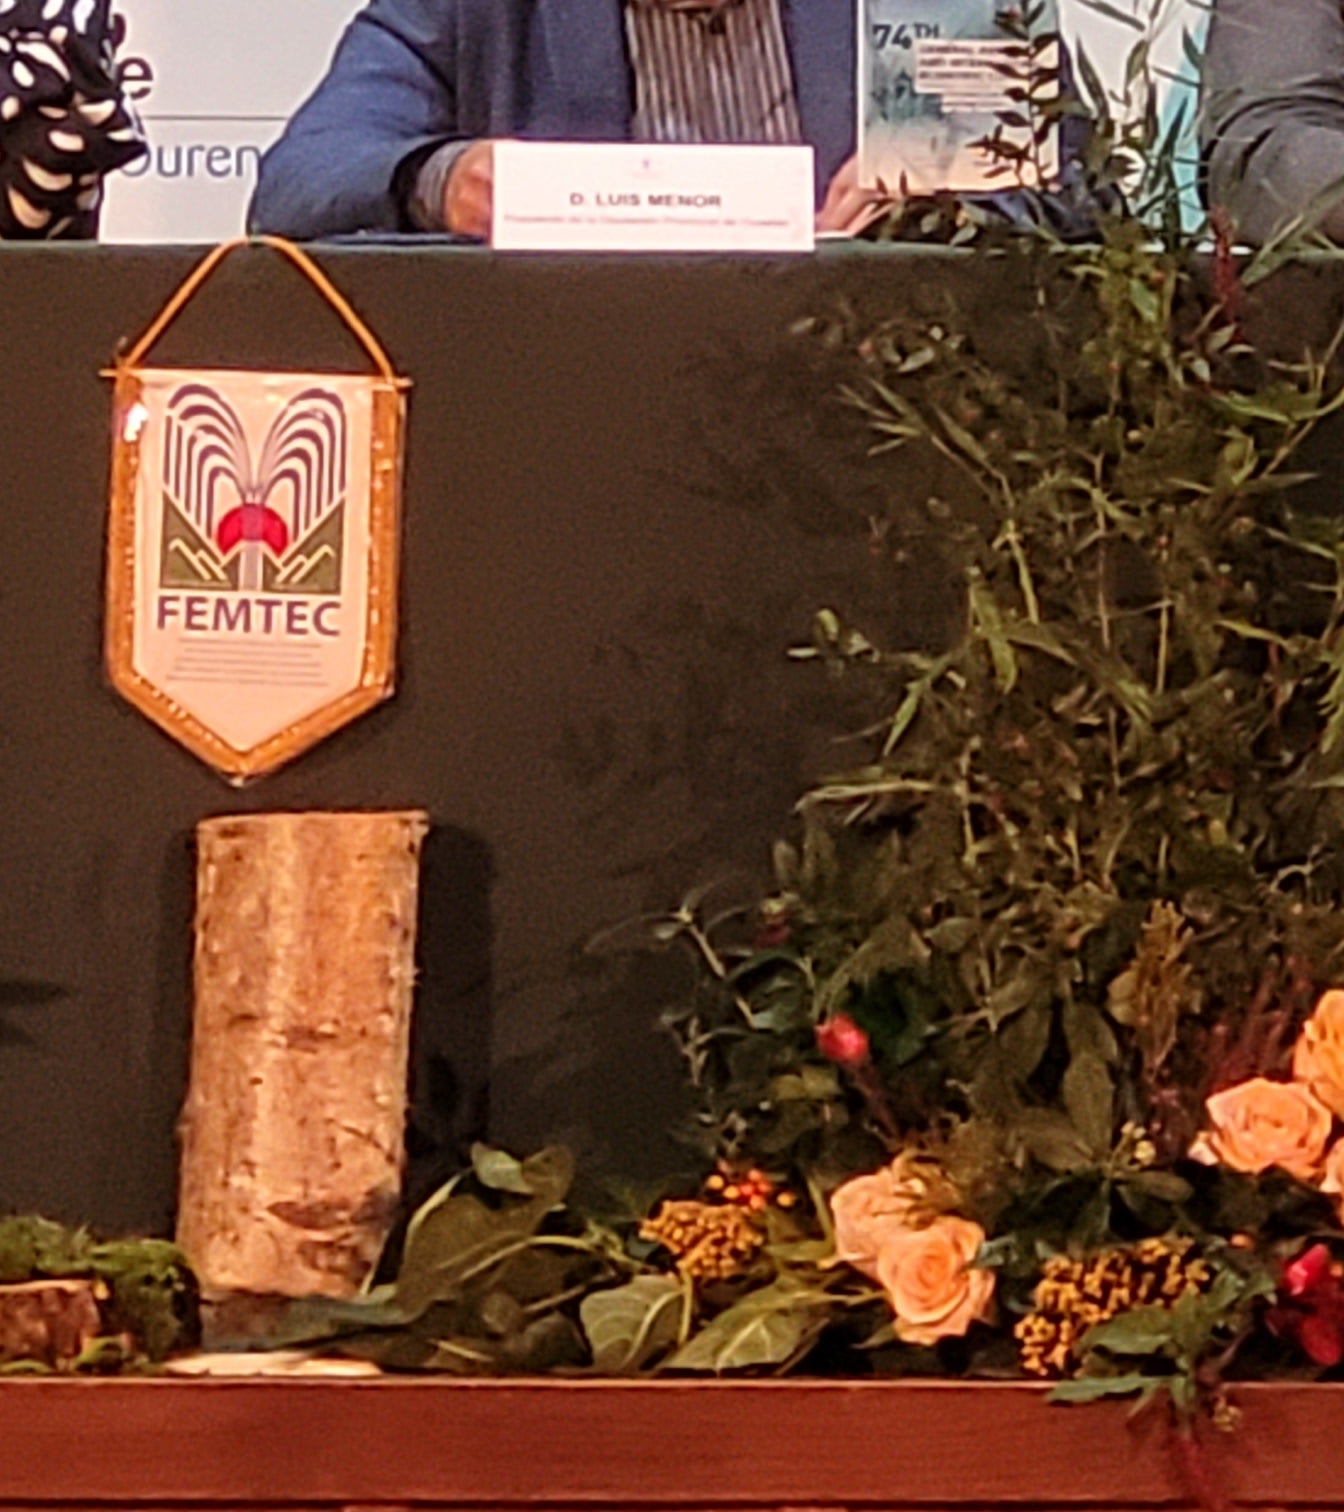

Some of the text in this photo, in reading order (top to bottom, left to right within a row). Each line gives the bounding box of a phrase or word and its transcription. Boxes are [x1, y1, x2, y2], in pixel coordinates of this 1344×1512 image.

[596, 194, 641, 207] LUIS
[647, 194, 722, 208] MENOR
[157, 595, 342, 637] FEMTEC
